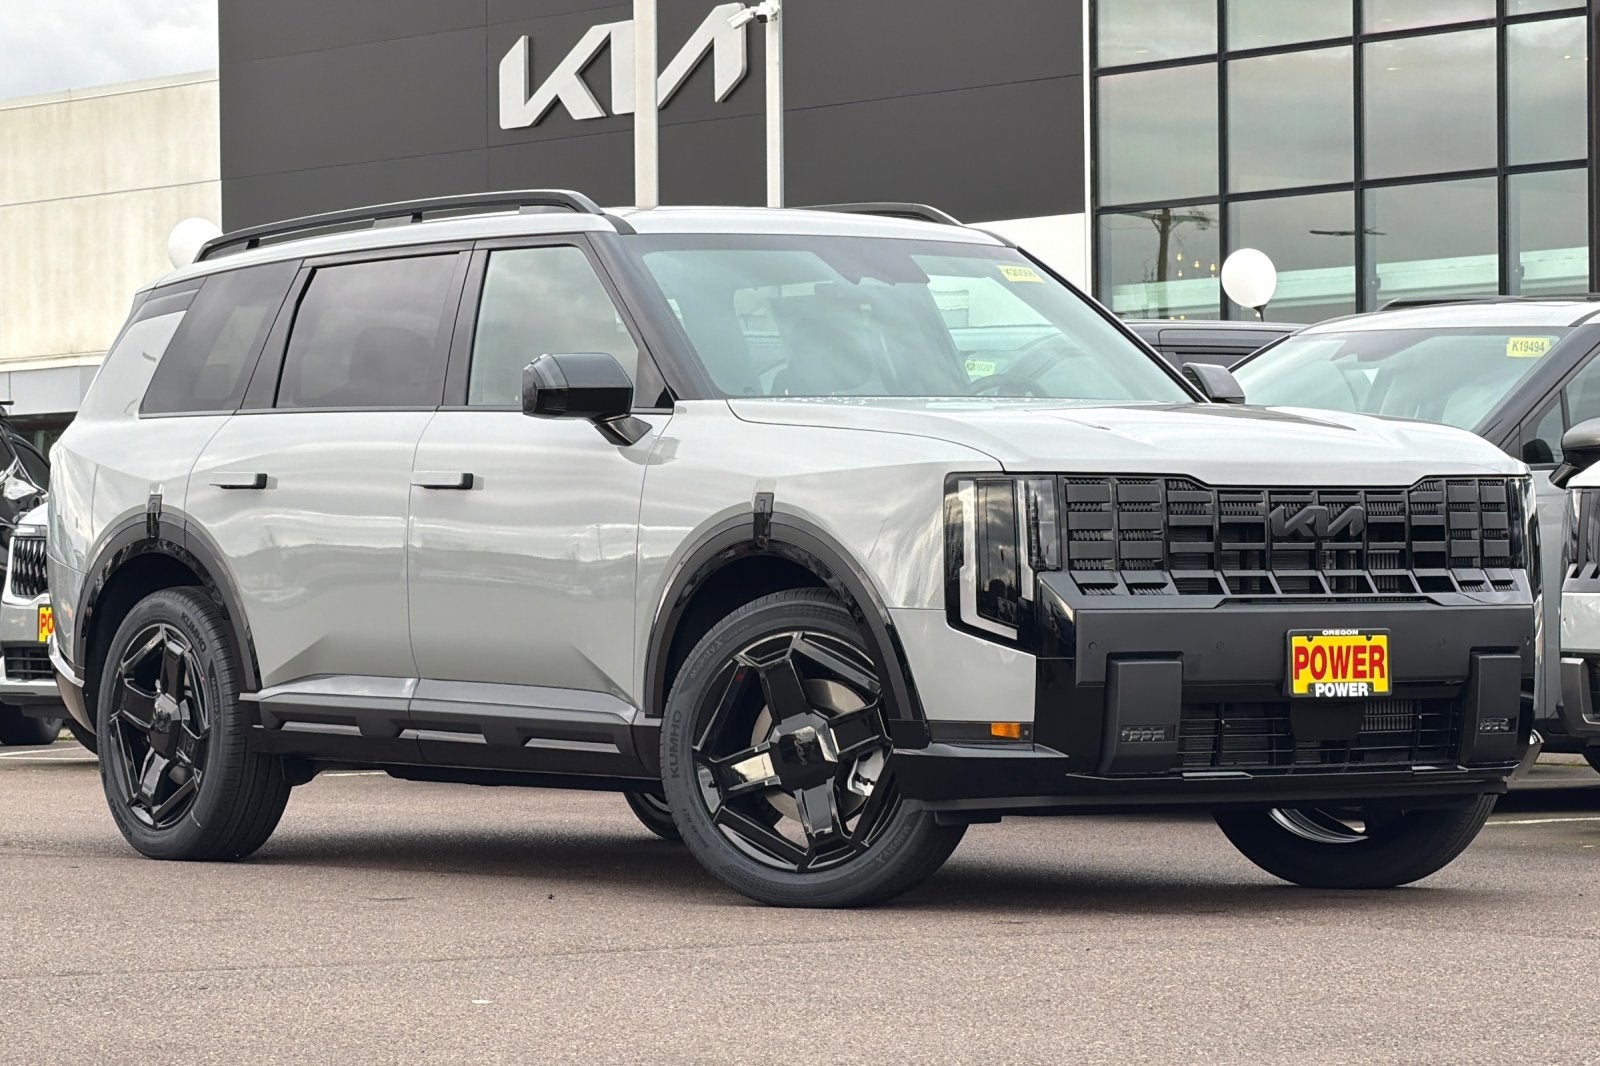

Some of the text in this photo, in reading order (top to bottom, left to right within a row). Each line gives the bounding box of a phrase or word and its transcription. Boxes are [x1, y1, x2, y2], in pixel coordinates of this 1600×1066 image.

[499, 2, 746, 129] KIA
[1512, 340, 1545, 352] K19494
[1268, 505, 1364, 537] KIA
[181, 612, 207, 652] KUMHO
[1294, 645, 1387, 680] POWER
[1315, 683, 1369, 697] POWER
[669, 710, 682, 779] KUMHO
